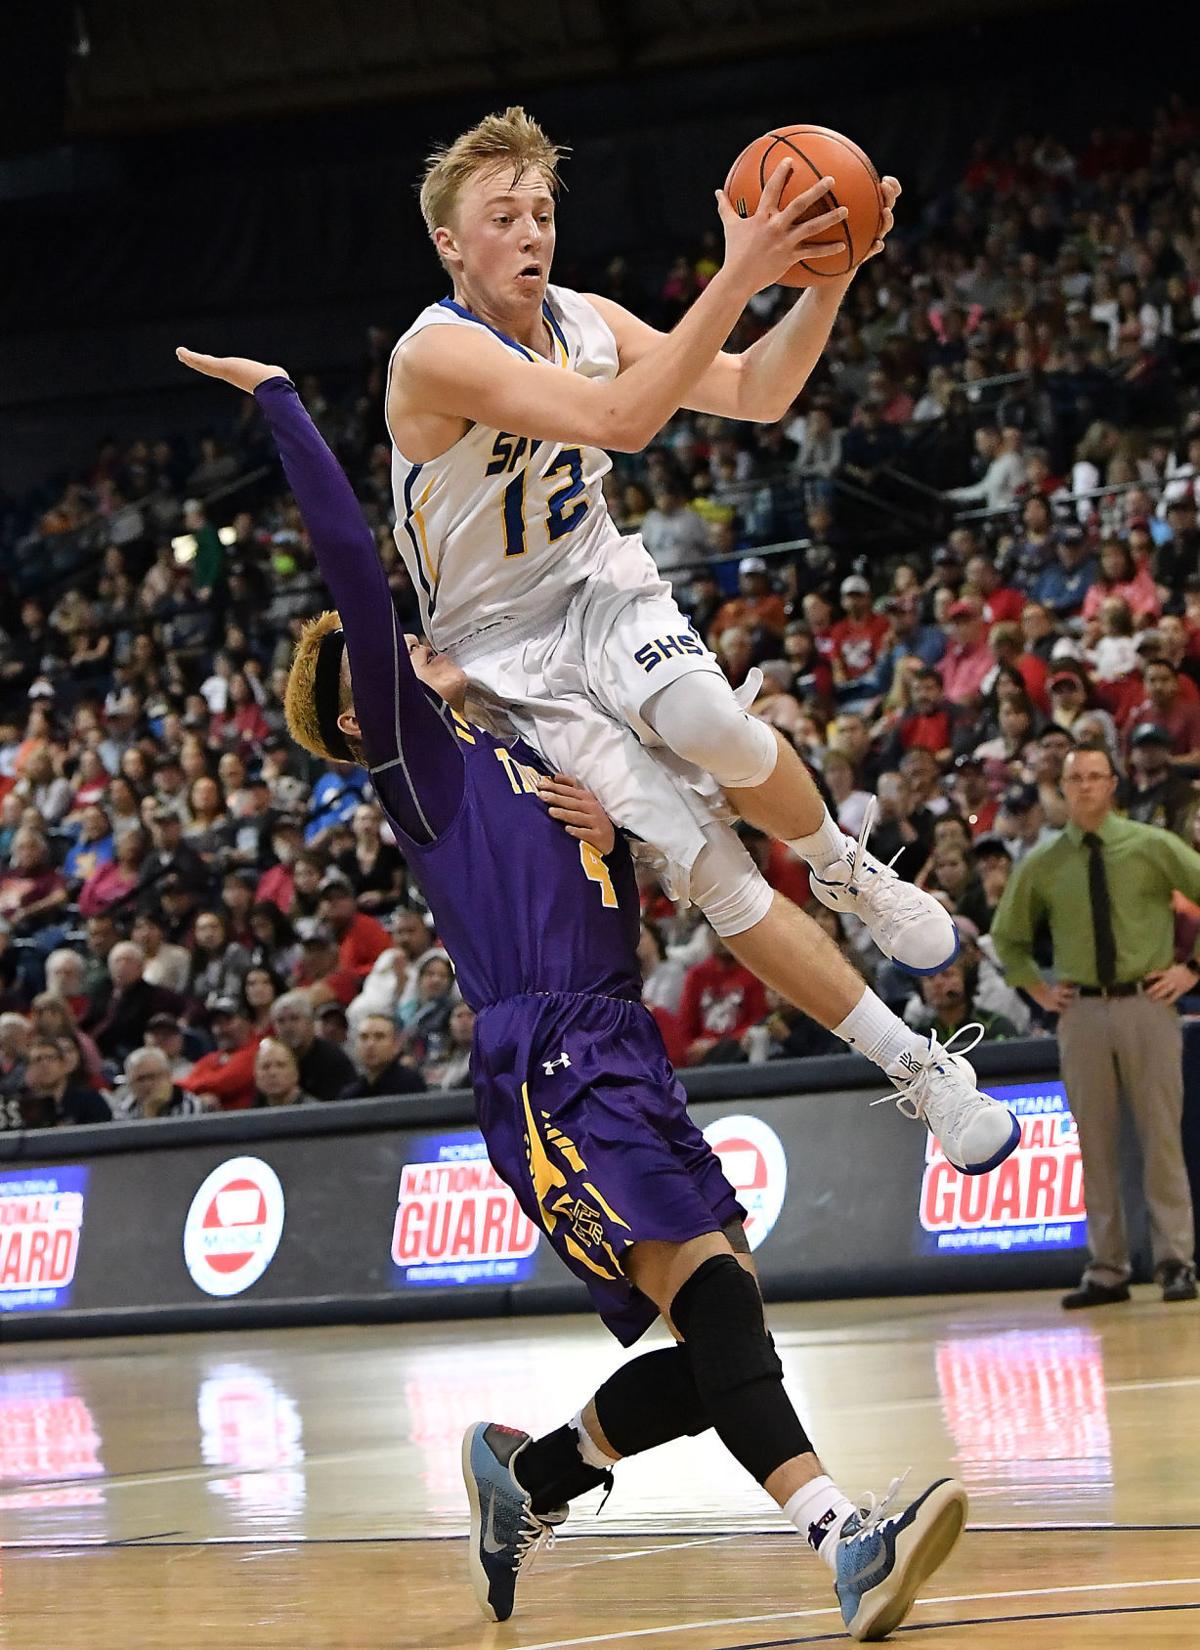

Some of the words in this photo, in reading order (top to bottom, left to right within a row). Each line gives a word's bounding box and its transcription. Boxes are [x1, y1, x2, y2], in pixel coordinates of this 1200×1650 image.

[501, 444, 590, 559] 12
[634, 634, 703, 673] SHS
[579, 839, 618, 908] 4
[925, 1154, 1084, 1225] GUARD
[0, 1229, 72, 1284] ARD
[399, 1197, 534, 1259] GUARD
